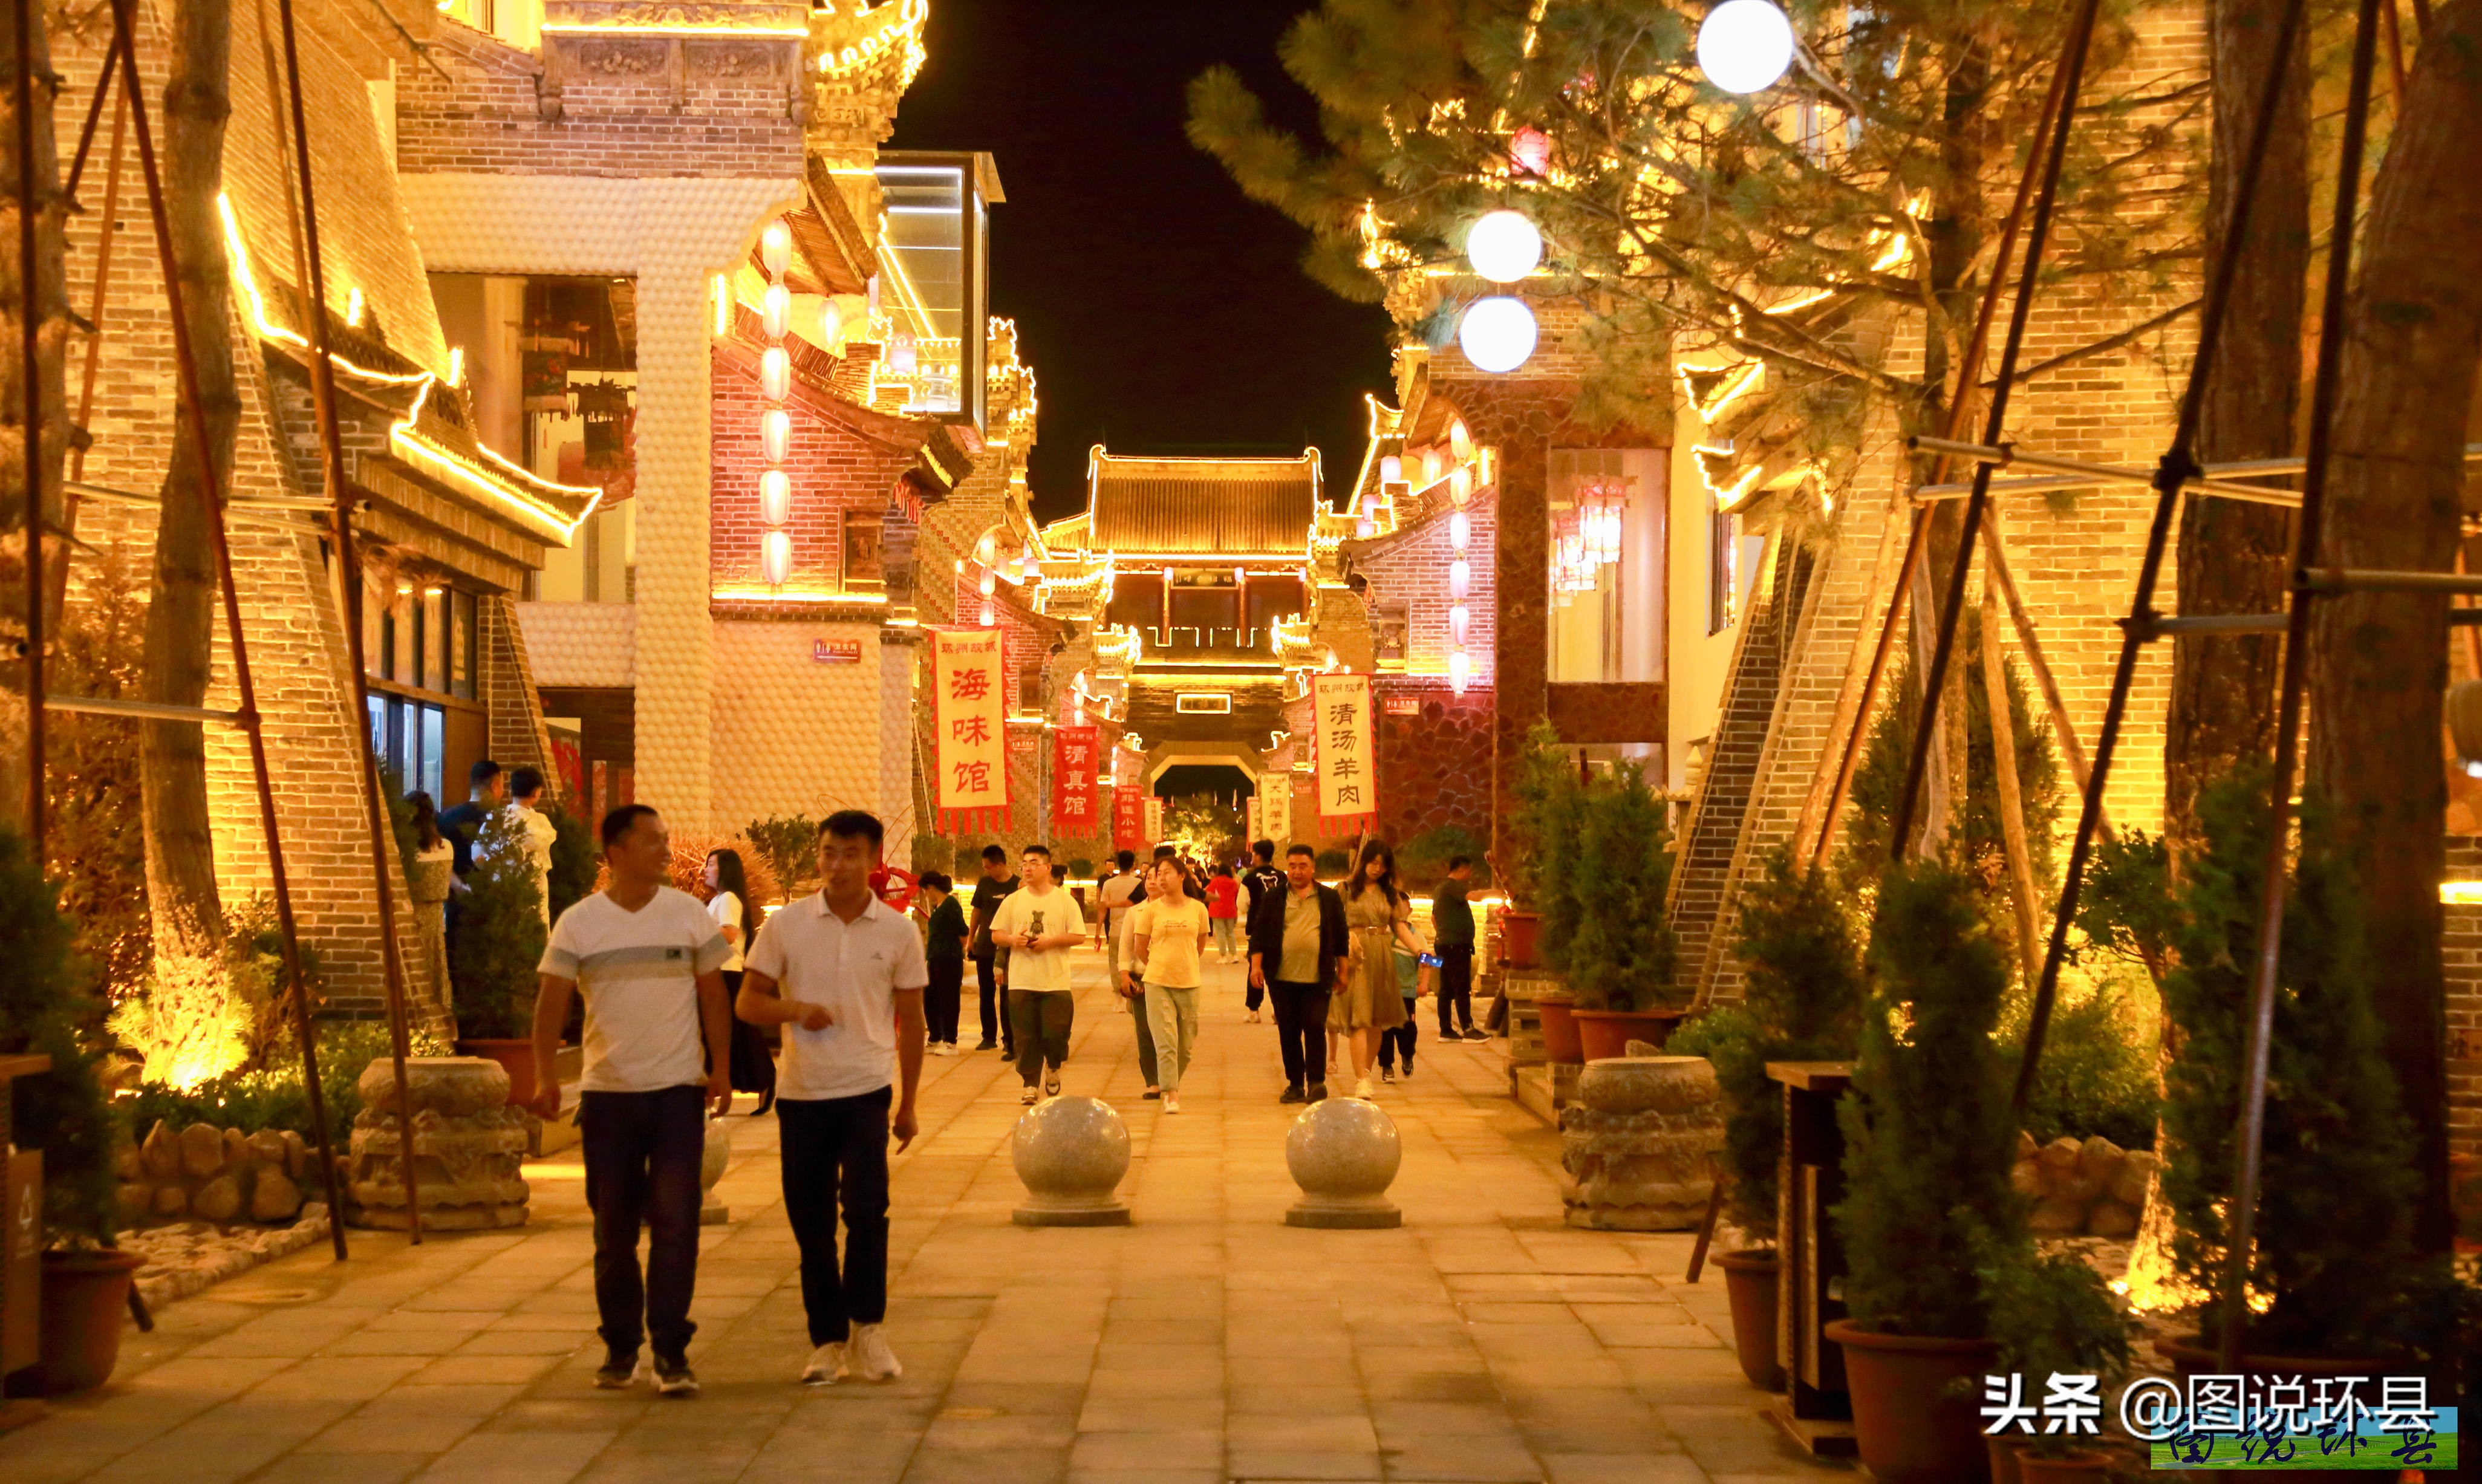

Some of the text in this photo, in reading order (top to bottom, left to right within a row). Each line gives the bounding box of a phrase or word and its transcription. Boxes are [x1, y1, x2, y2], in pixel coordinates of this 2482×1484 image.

[951, 668, 991, 793] 海味馆
[1064, 745, 1088, 815] 清真馆
[1331, 703, 1360, 807] 清汤羊肉
